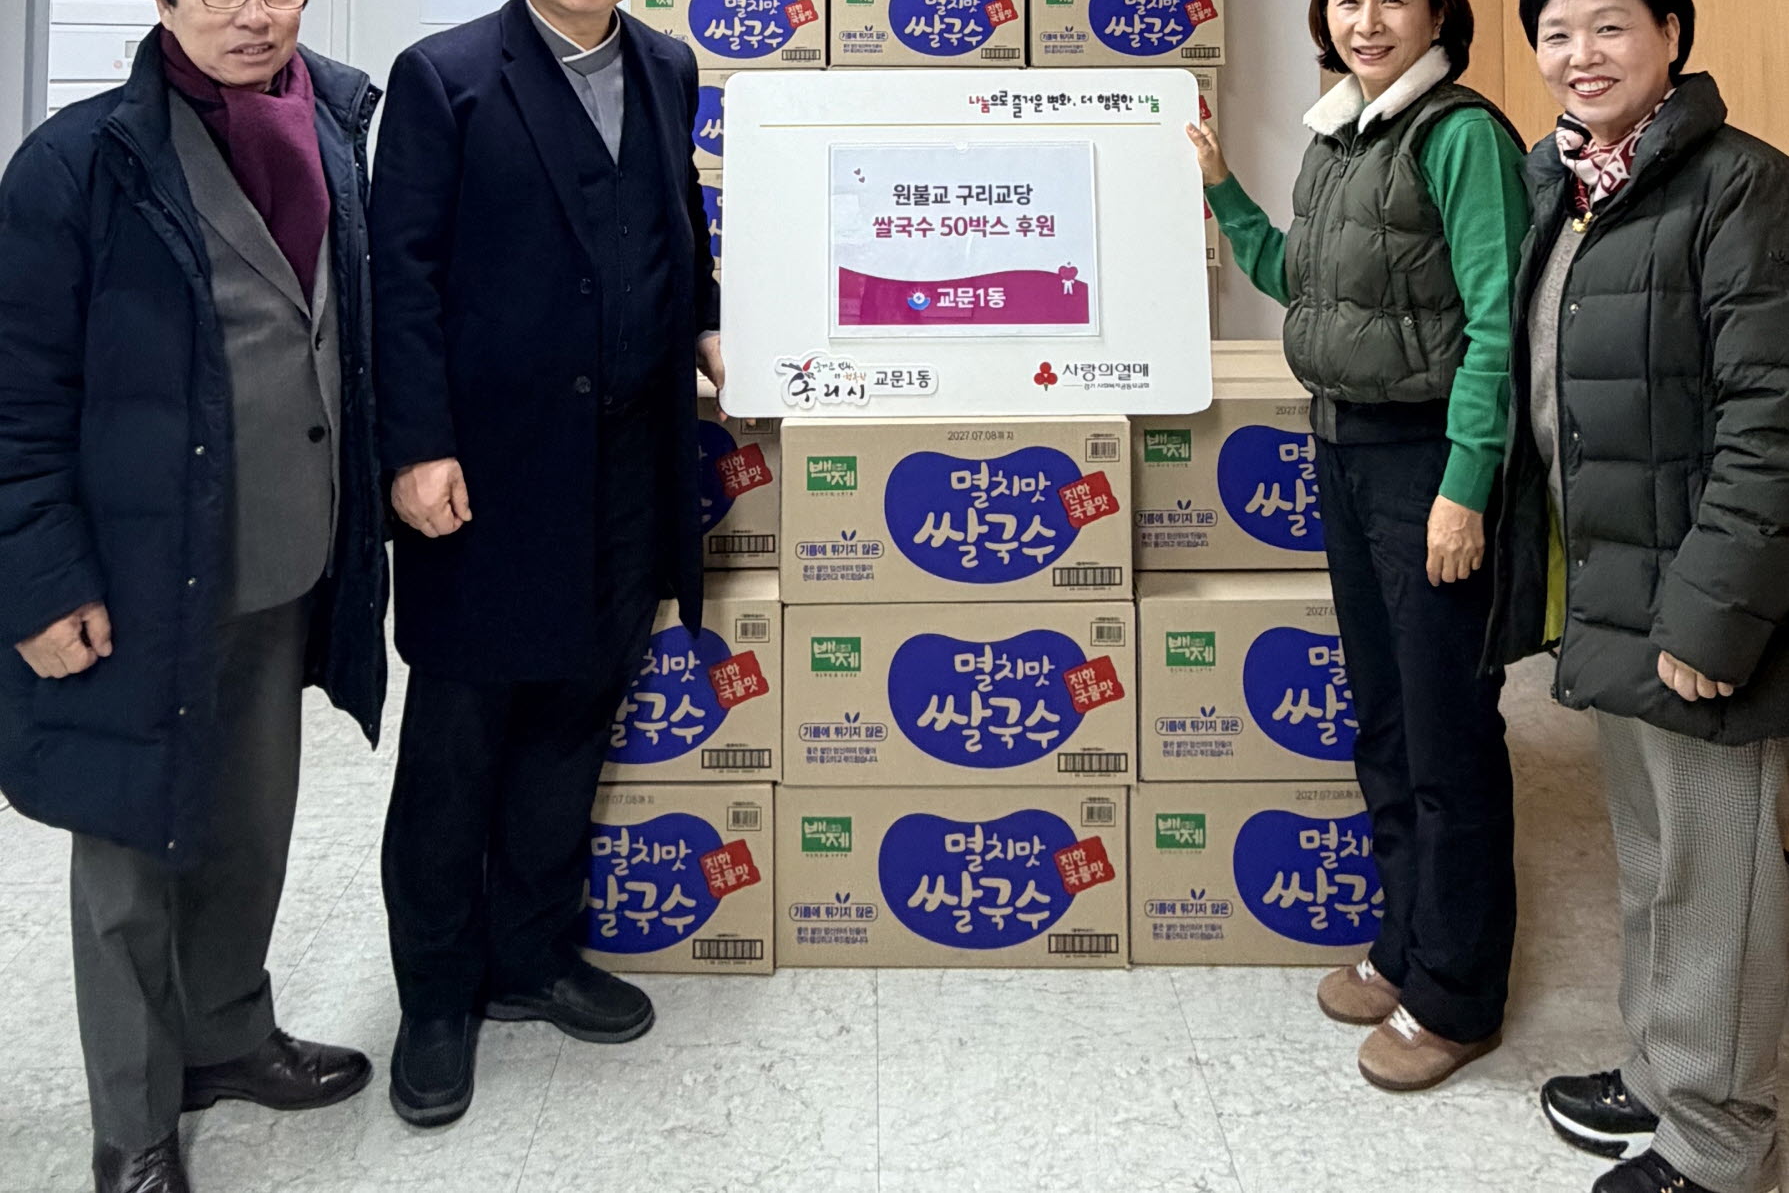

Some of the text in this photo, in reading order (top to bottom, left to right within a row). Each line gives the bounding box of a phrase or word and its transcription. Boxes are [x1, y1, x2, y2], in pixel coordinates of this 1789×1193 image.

[704, 16, 783, 50] 쌀국수
[904, 14, 983, 48] 쌀국수
[1104, 14, 1183, 48] 쌀국수
[969, 90, 1008, 114] 나눔으로
[1012, 94, 1043, 118] 즐거운
[1081, 95, 1093, 104] 더
[1097, 93, 1133, 112] 행복한
[1138, 95, 1160, 113] 나눔
[892, 183, 1033, 206] 원불교 구리교당
[873, 214, 1056, 238] 쌀국수 50박스 후원
[936, 287, 1006, 308] 교문1동
[874, 370, 931, 388] 교문1동
[1062, 362, 1149, 382] 사랑의열매
[1146, 433, 1190, 458] 백제
[721, 455, 746, 475] 진한
[727, 466, 763, 489] 국물맛
[809, 460, 855, 487] 백제
[950, 462, 1051, 509] 멸치맛
[1063, 484, 1092, 505] 진한
[1070, 494, 1110, 519] 국물맛
[913, 508, 1056, 568] 쌀국수
[813, 641, 859, 668] 백제
[1168, 635, 1214, 663] 백제
[631, 648, 700, 687] 치맛
[713, 663, 741, 685] 진한
[954, 644, 1055, 692] 멸치맛
[1068, 668, 1096, 689] 진한
[720, 674, 759, 700] 국물맛
[1075, 679, 1114, 704] 국물맛
[917, 691, 1060, 753] 쌀국수
[803, 821, 850, 848] 백제
[1158, 817, 1204, 845] 백제
[591, 828, 692, 876] 멸치맛
[944, 824, 1046, 873] 멸치맛
[1300, 820, 1373, 869] 멸치
[704, 852, 732, 874] 진한
[1058, 848, 1087, 870] 진한
[1065, 859, 1105, 885] 국물맛
[711, 864, 750, 889] 국물맛
[907, 871, 1051, 934] 쌀국수
